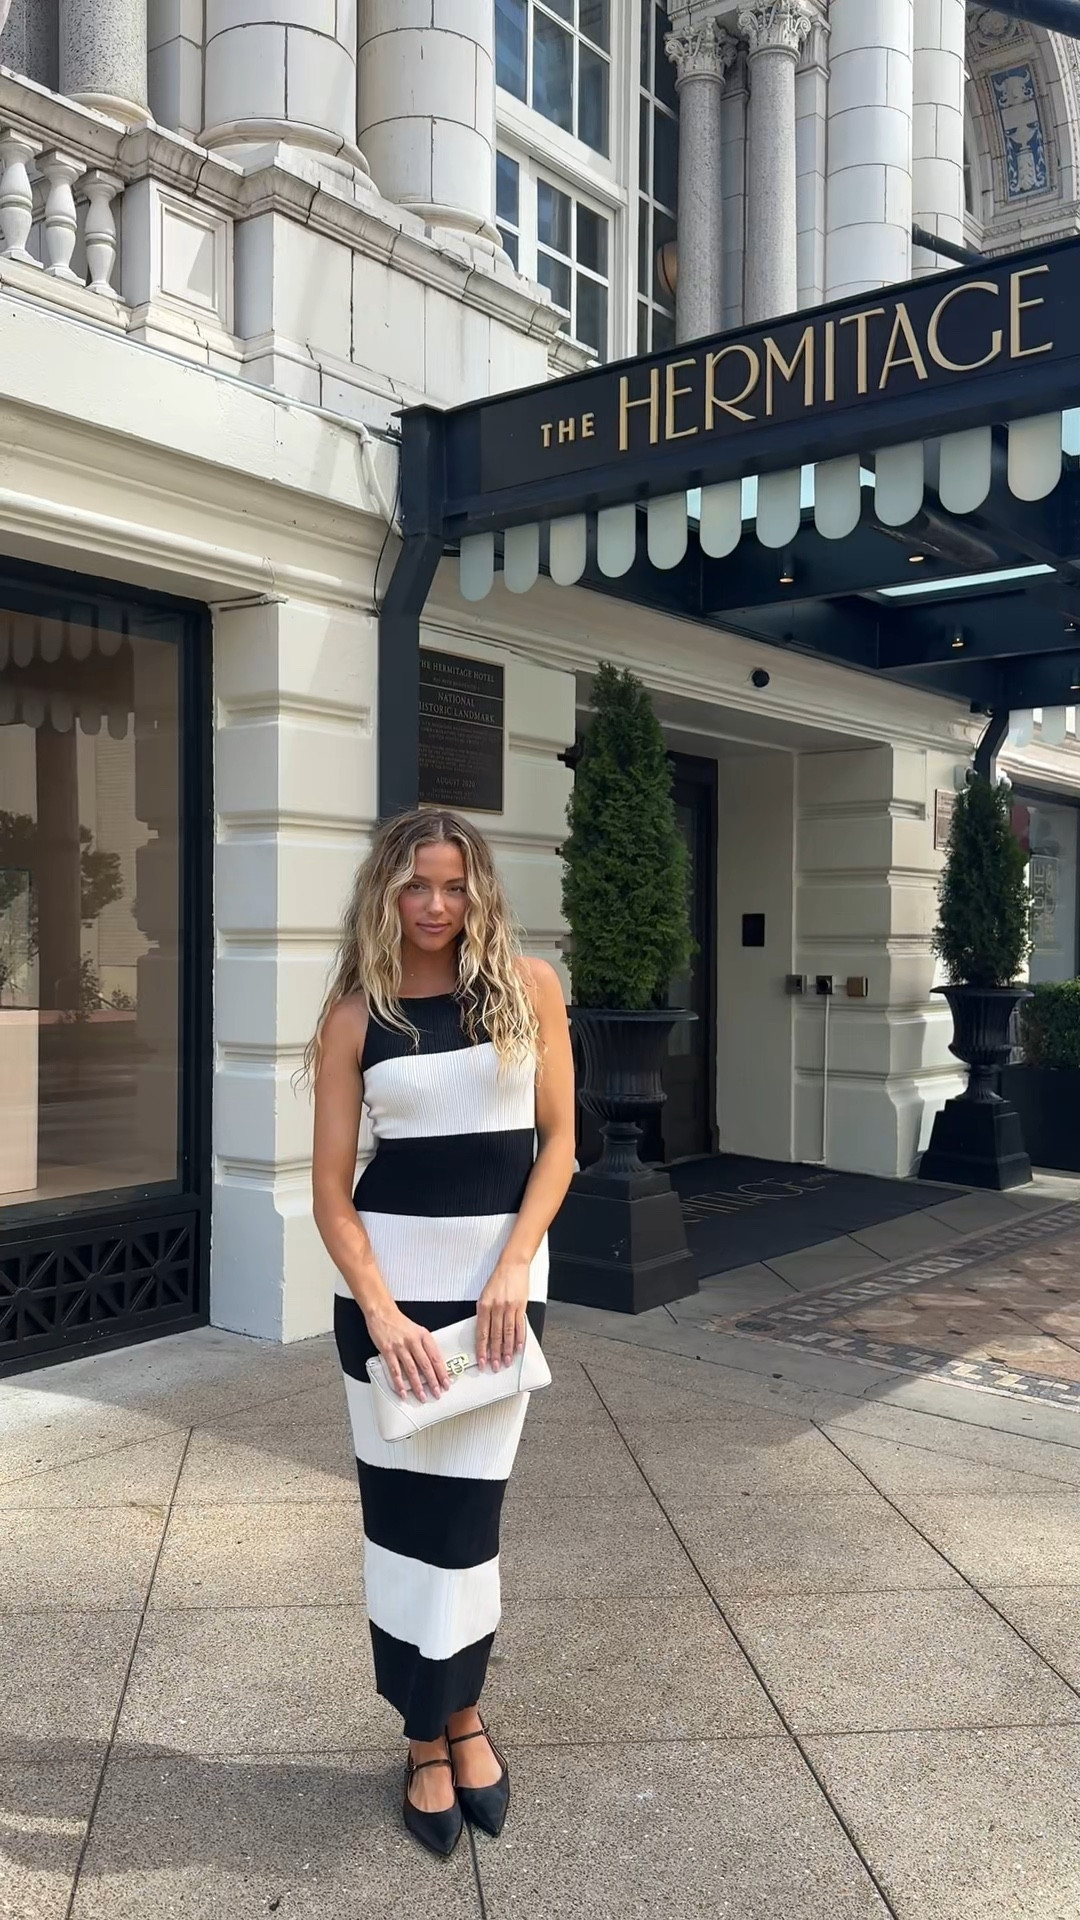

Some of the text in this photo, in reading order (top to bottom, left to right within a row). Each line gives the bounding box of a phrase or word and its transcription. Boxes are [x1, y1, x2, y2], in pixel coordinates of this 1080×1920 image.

[541, 264, 1054, 452] THE HERMITAGE
[420, 659, 495, 683] HE HERMITAGE HOTEL
[438, 691, 475, 708] NATIONAL
[453, 706, 496, 723] LANDMARK
[1033, 863, 1045, 923] RUSIE
[680, 1177, 826, 1222] MITAGE
